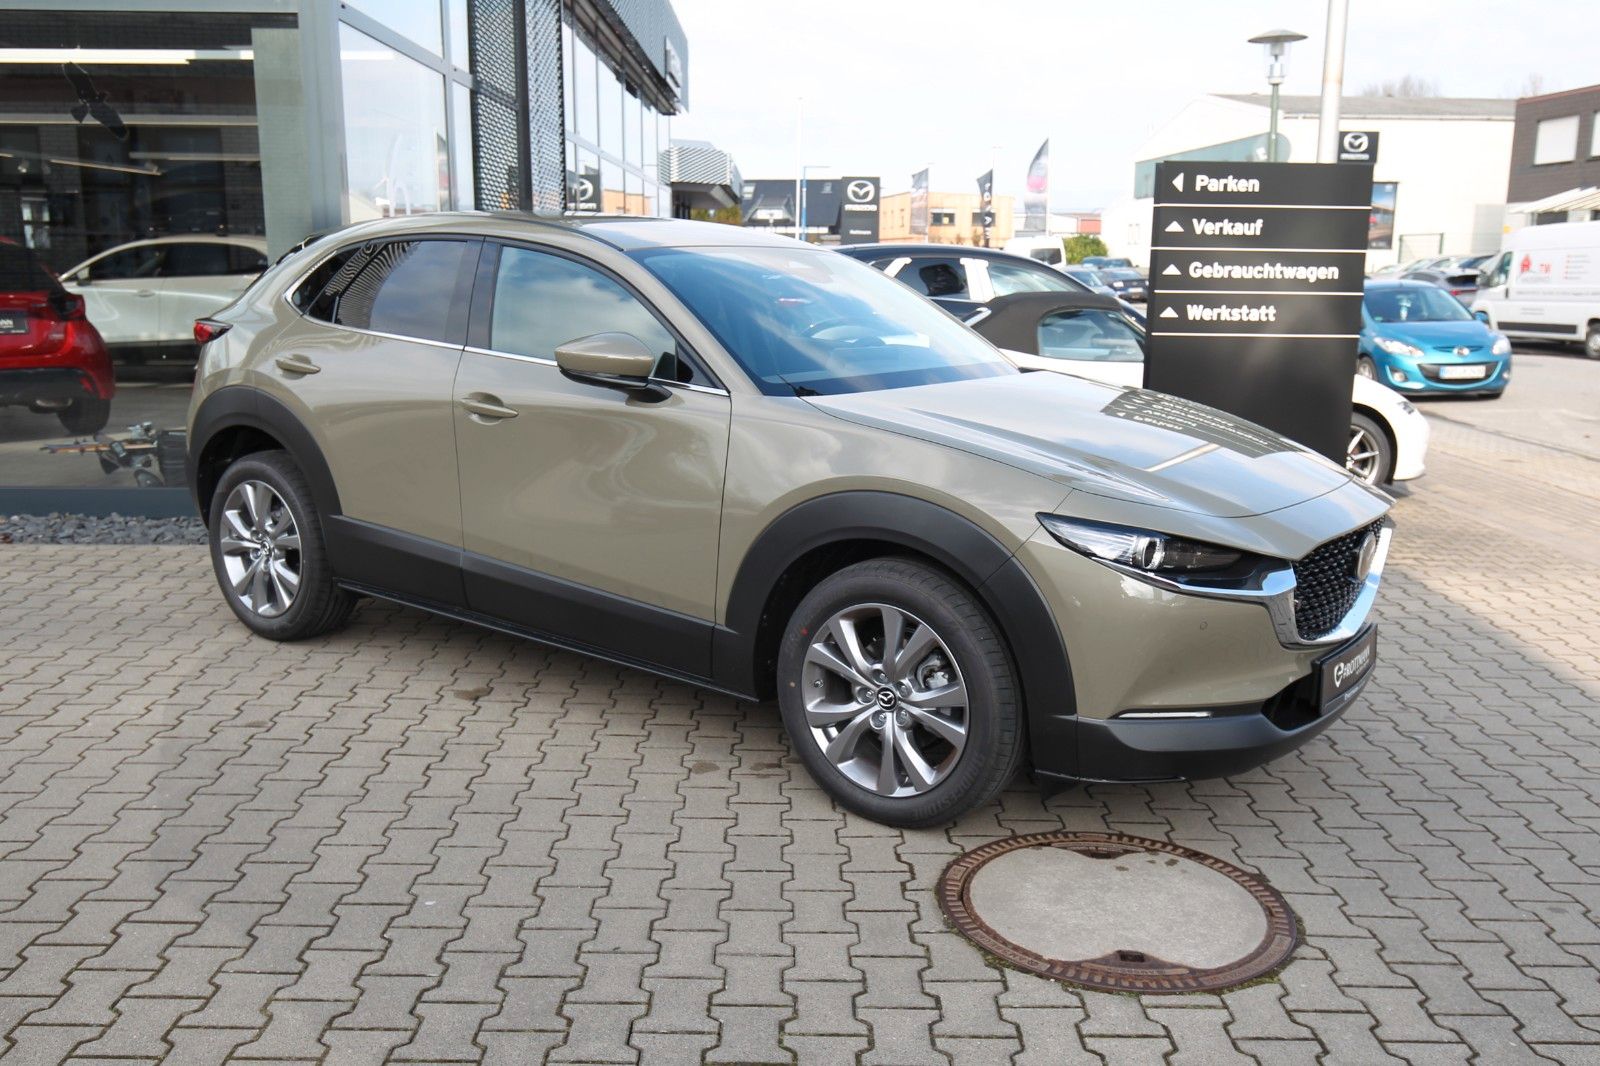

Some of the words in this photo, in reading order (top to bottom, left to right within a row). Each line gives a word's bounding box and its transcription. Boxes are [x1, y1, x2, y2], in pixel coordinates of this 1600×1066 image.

[1195, 175, 1259, 192] Parken
[1192, 218, 1263, 235] Verkauf
[1189, 262, 1339, 283] Gebrauchtwagen
[1187, 304, 1276, 321] Werkstatt
